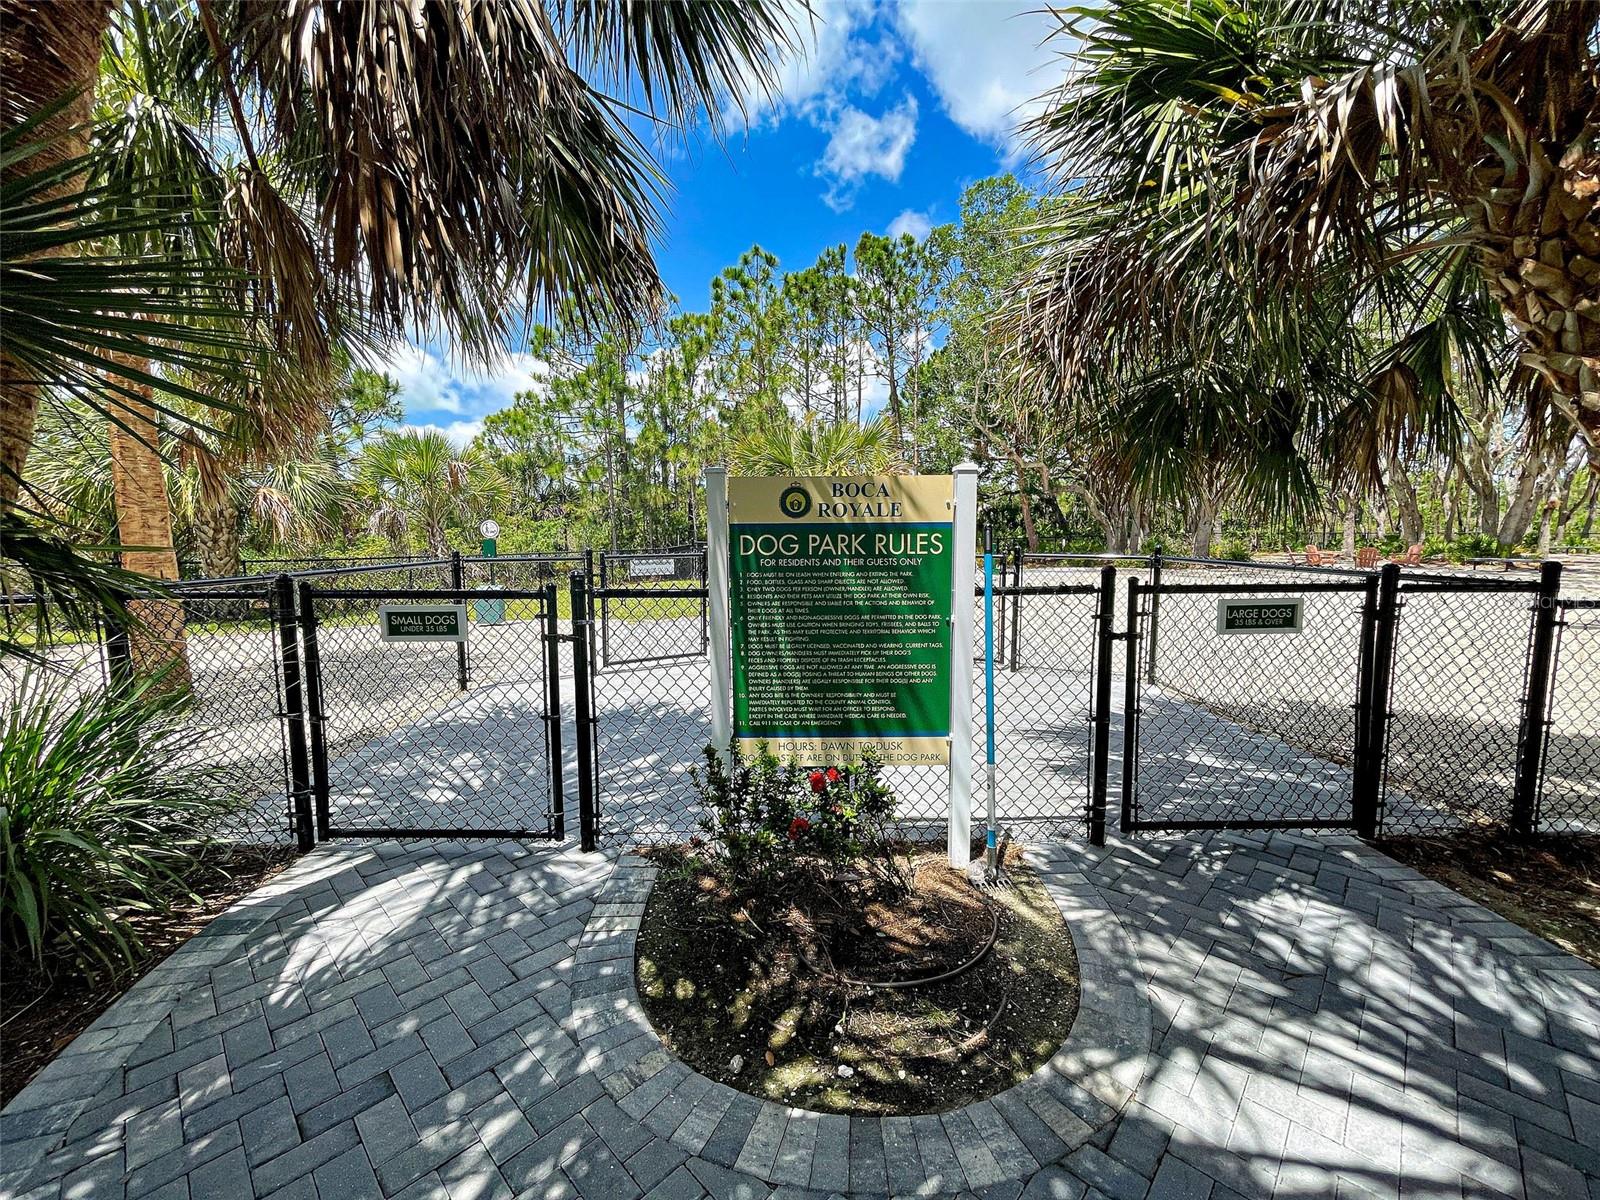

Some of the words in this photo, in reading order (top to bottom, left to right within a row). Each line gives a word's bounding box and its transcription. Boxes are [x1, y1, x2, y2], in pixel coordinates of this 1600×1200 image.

[832, 483, 890, 498] BOCA
[817, 502, 903, 518] ROYALE
[740, 534, 799, 556] DOG
[808, 533, 866, 556] PARK
[875, 532, 944, 555] RULES
[760, 558, 777, 567] FOR
[778, 558, 820, 567] RESIDENTS
[822, 558, 842, 567] AND
[843, 558, 865, 566] THEIR
[866, 557, 898, 566] GUESTS
[899, 557, 923, 566] ONLY
[1228, 609, 1258, 618] LARGE
[1262, 608, 1292, 618] DOGS
[391, 616, 422, 624] SMALL
[425, 616, 456, 624] DOGS
[778, 742, 816, 751] HOURS:
[820, 742, 854, 750] DAWN
[876, 742, 903, 750] DUSK
[825, 754, 840, 762] ON
[842, 754, 862, 762] DUT
